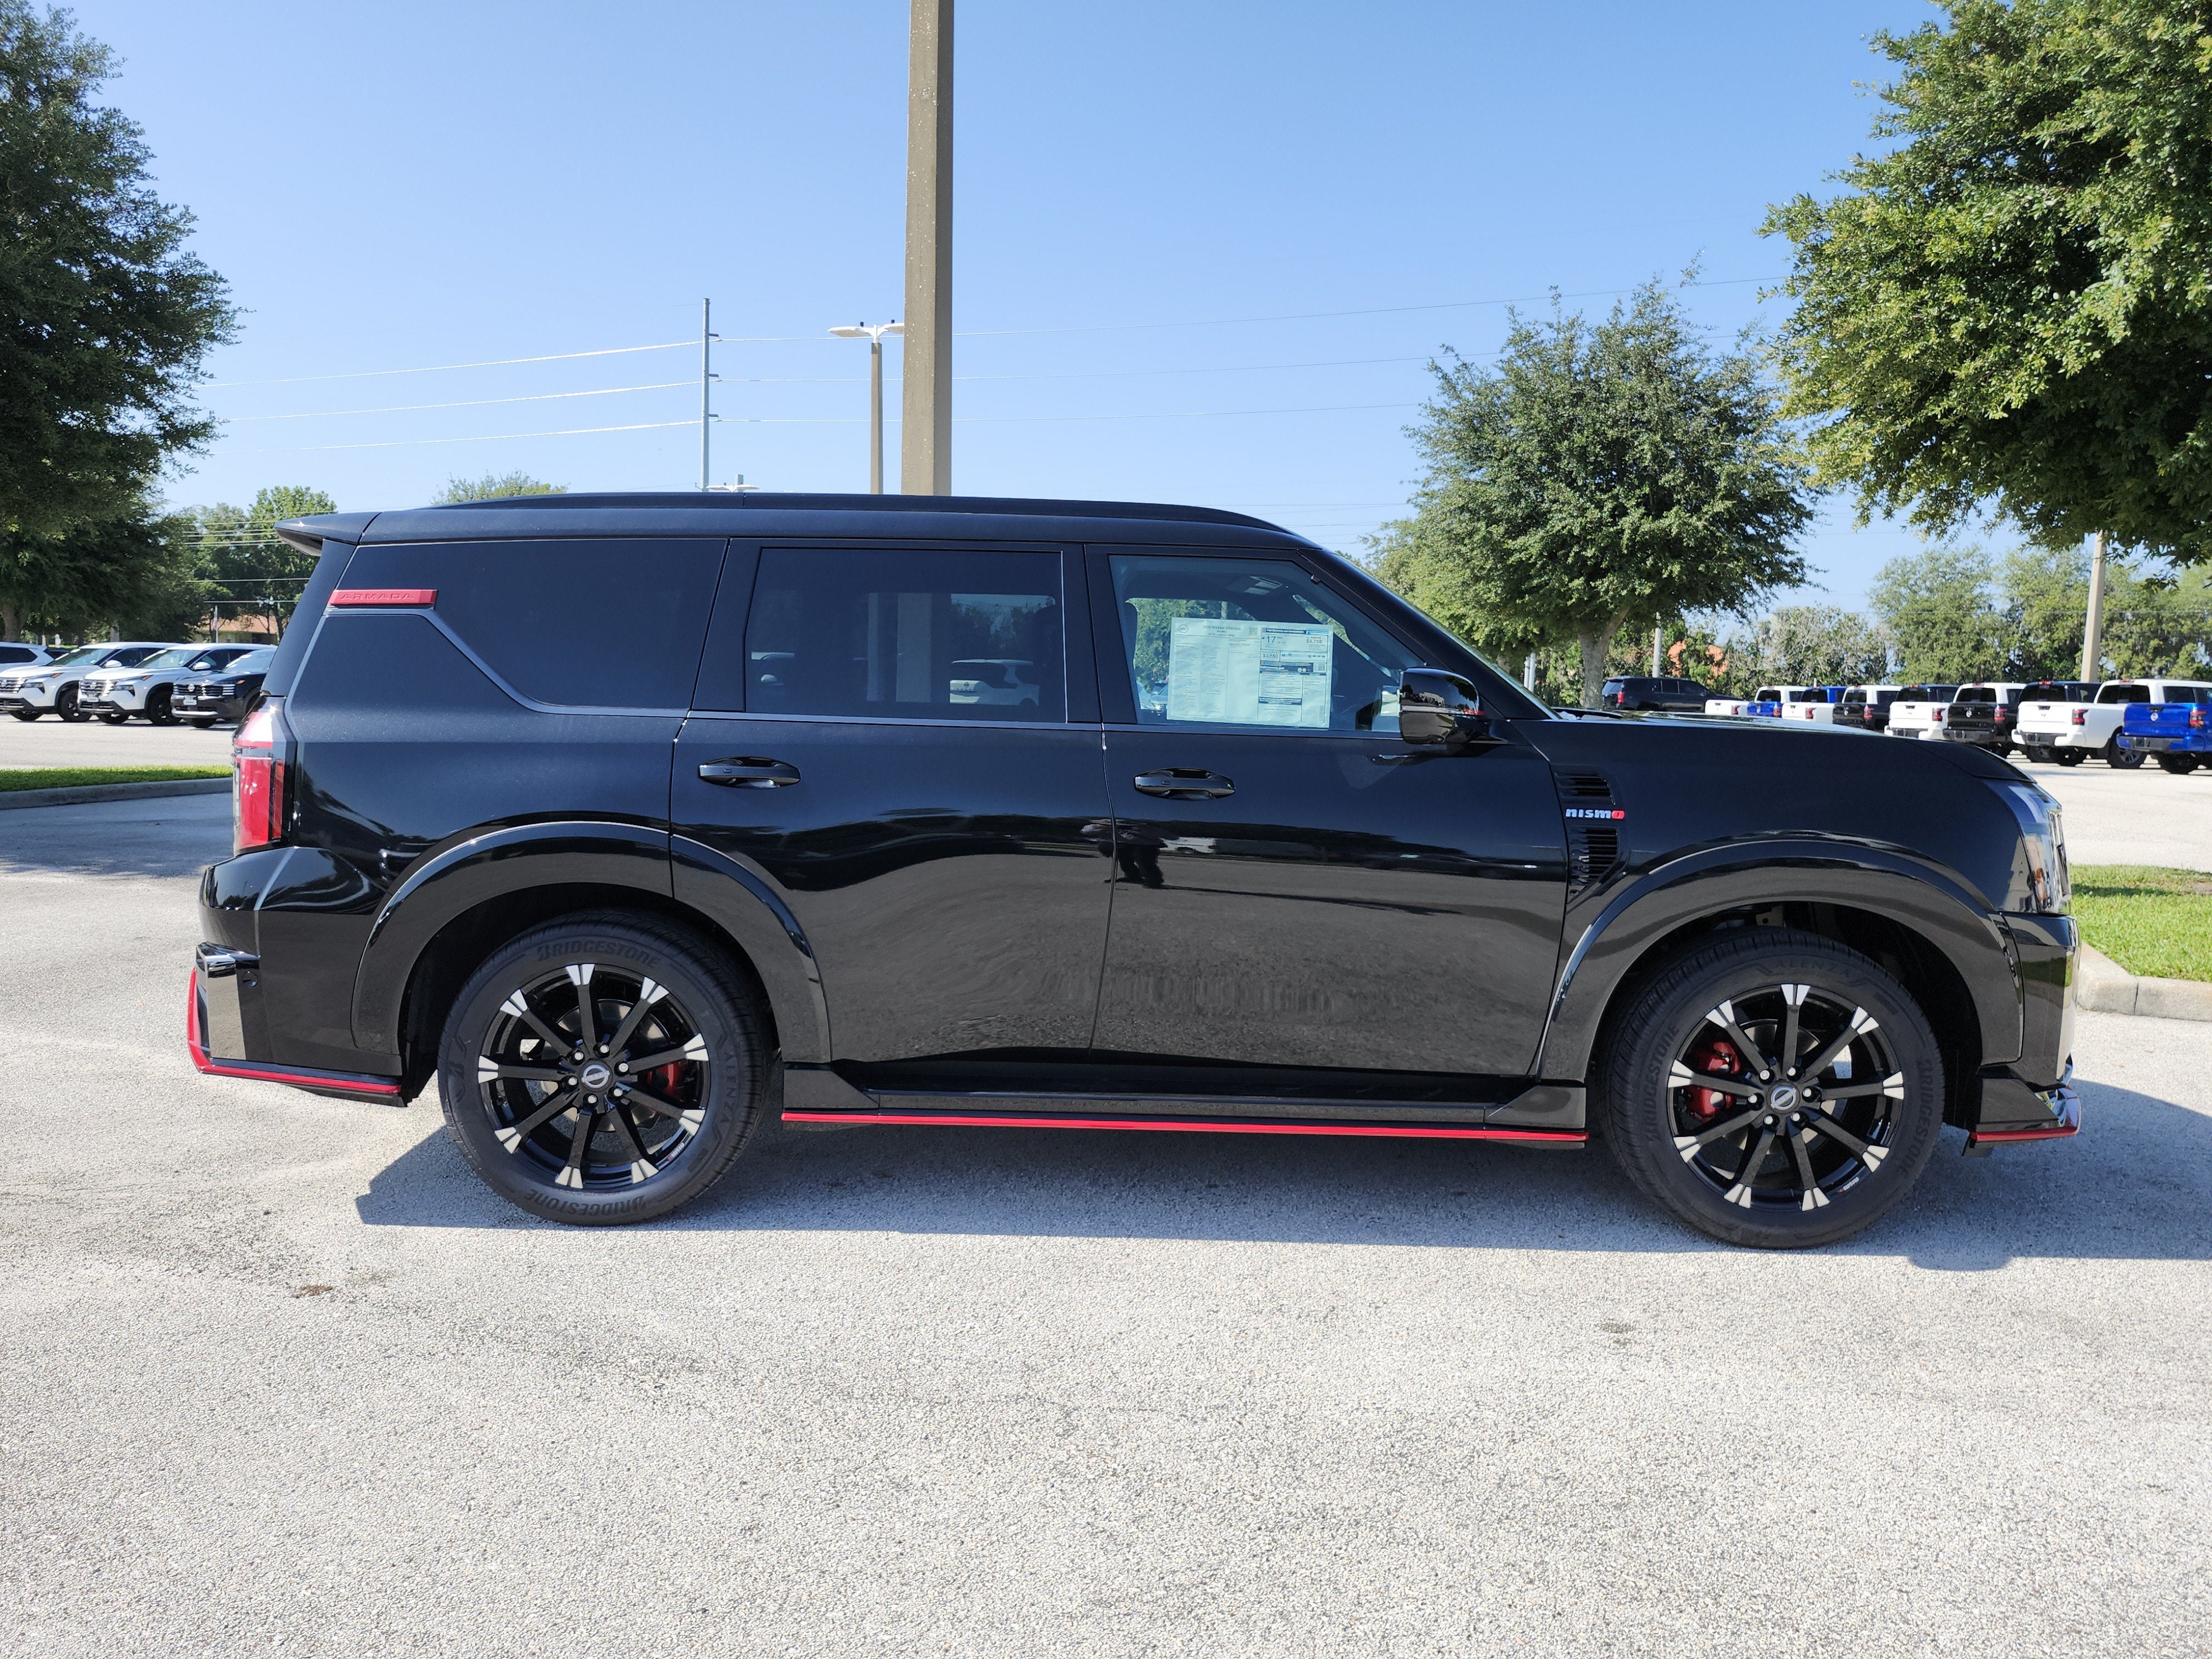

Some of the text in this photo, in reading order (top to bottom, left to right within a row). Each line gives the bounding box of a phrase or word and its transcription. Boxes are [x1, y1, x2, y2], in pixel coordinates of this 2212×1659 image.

[536, 940, 661, 969] BRIDGESTONE
[720, 1050, 737, 1126] ALENZA
[1644, 1021, 1679, 1142] BRIDGESTONE
[1902, 1058, 1933, 1179] BRIDGESTONE
[524, 1188, 648, 1217] BRIDGESTONE
